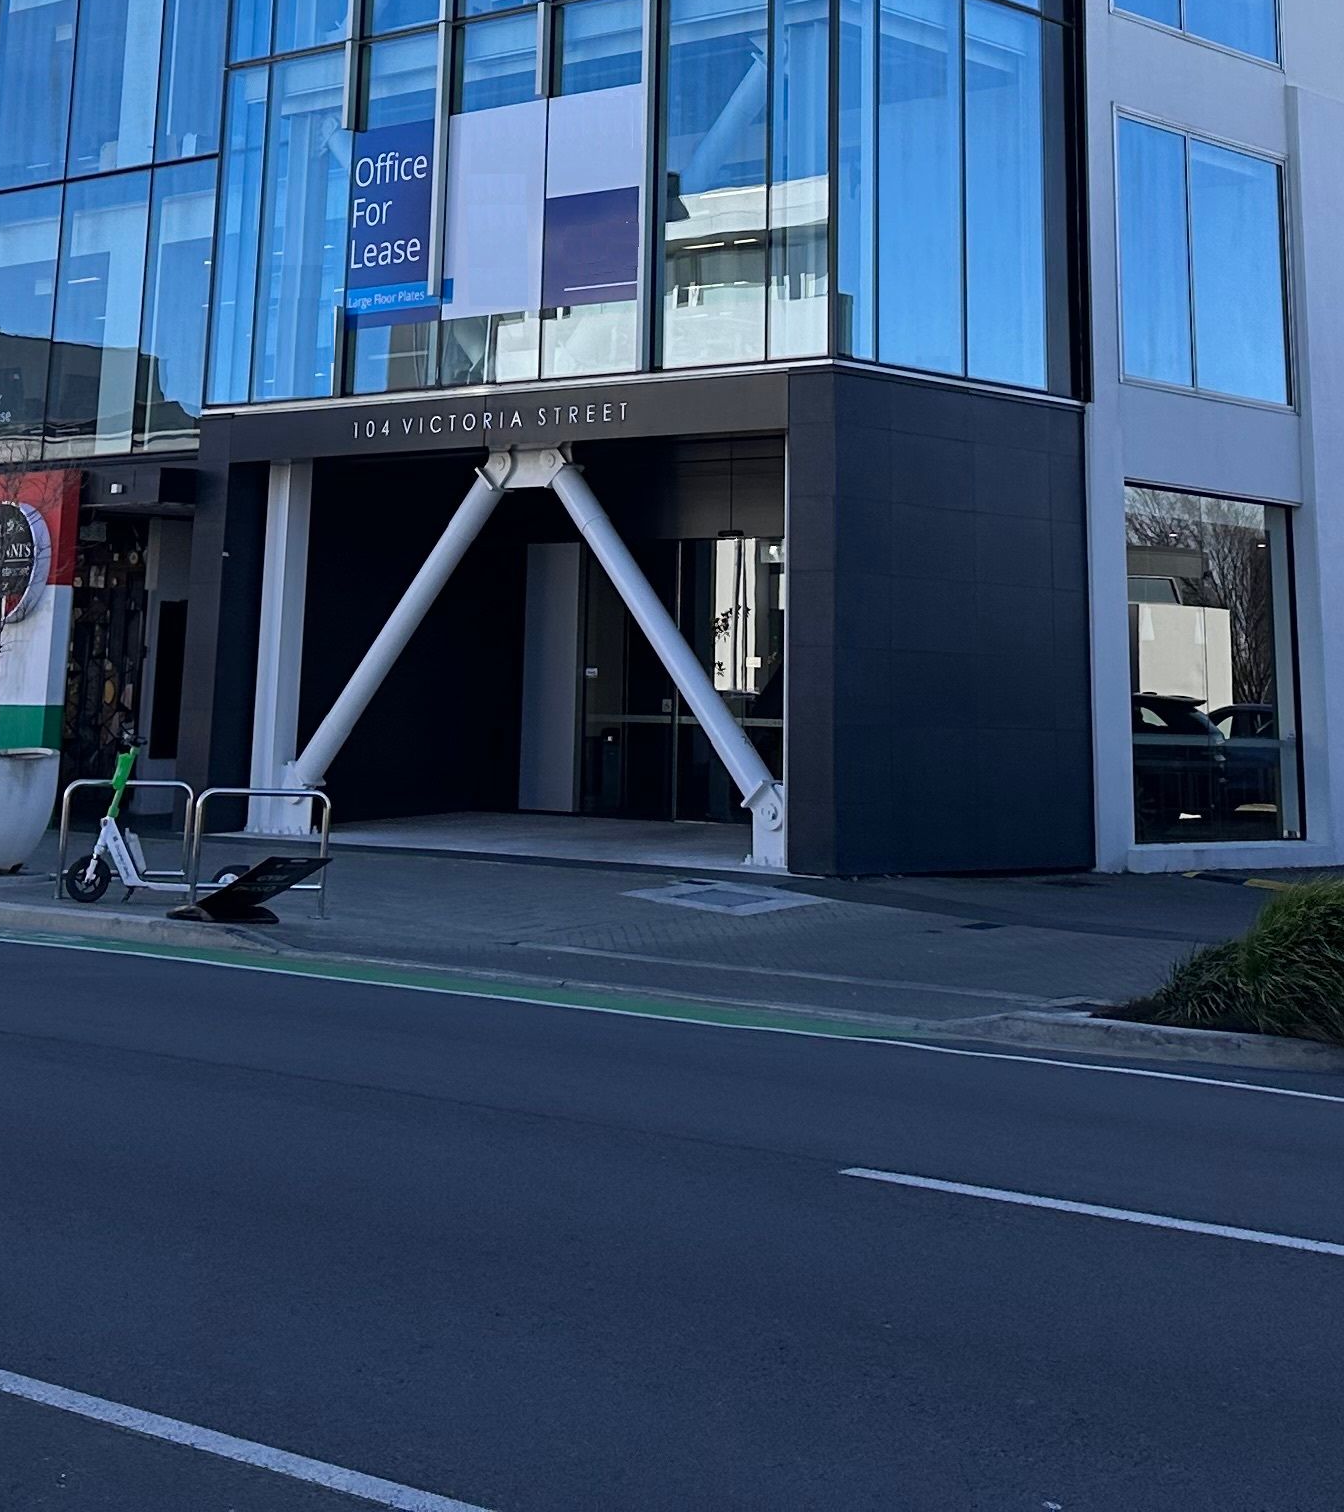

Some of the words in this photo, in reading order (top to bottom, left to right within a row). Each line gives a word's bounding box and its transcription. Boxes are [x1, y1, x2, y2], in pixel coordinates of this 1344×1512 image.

[355, 152, 428, 188] Office
[352, 197, 393, 229] For
[350, 238, 421, 269] Lease
[348, 296, 373, 310] Large
[373, 292, 397, 306] Floor
[397, 290, 425, 303] Plates
[352, 419, 390, 439] 104
[402, 410, 523, 434] VICTORIA
[537, 402, 628, 427] STREET
